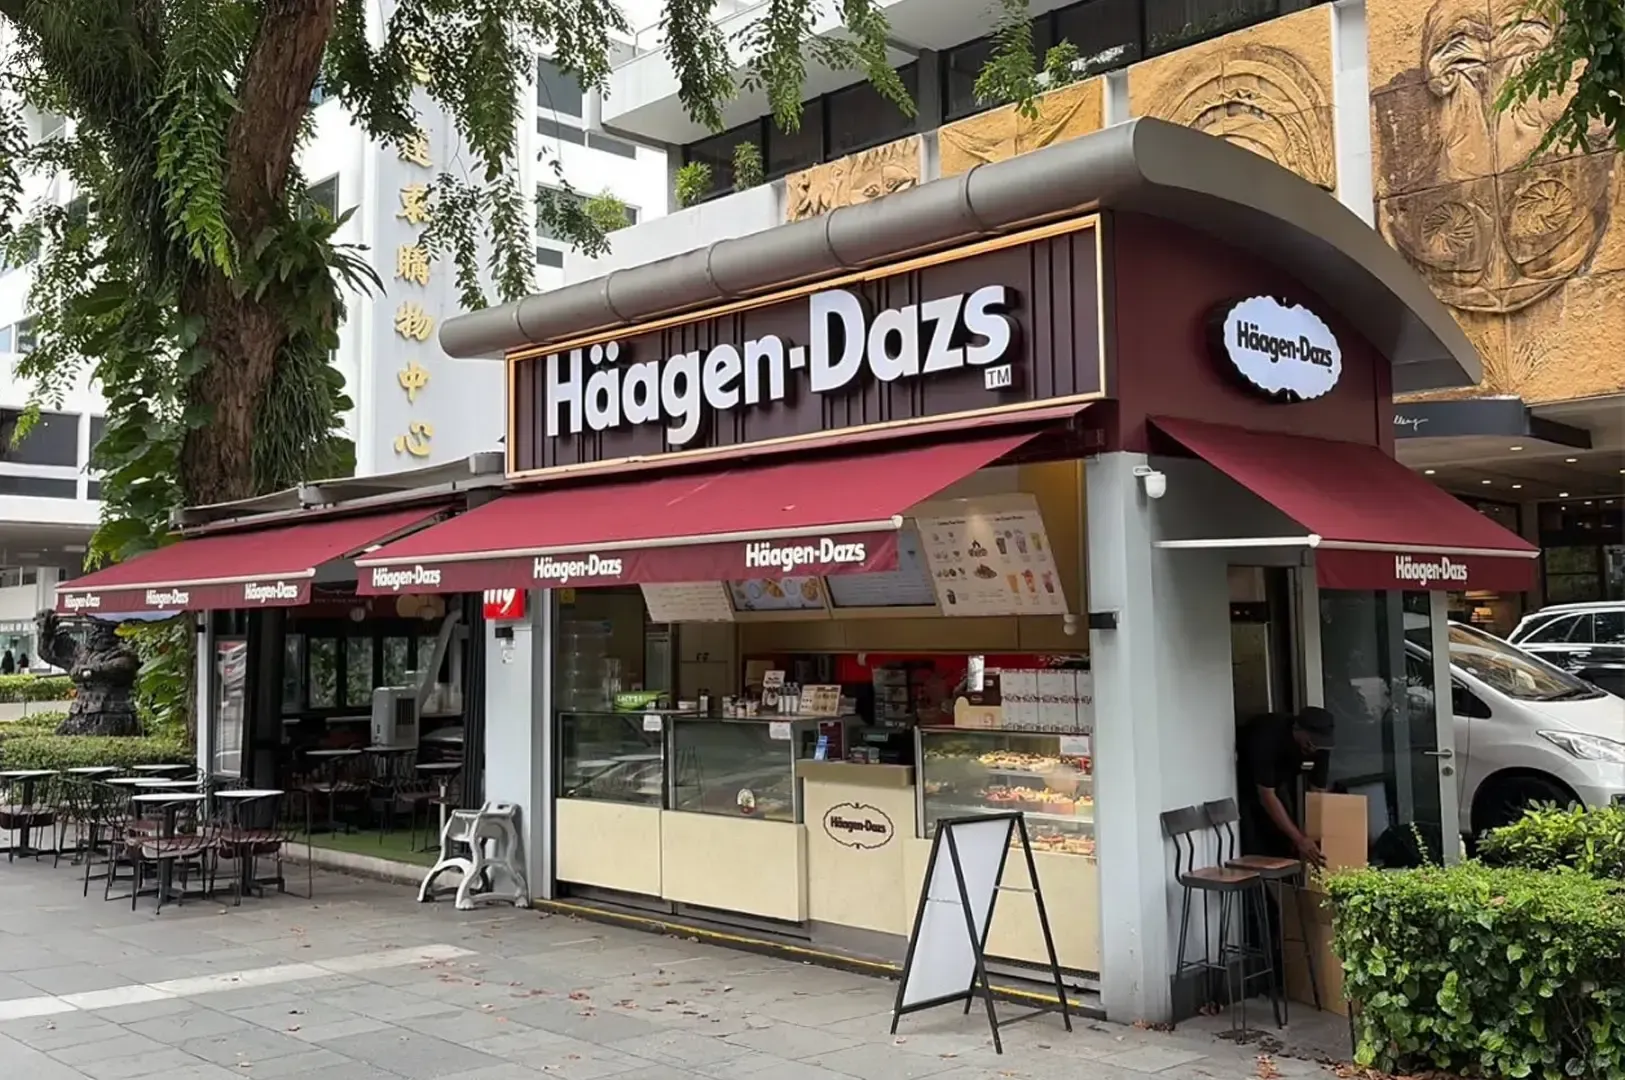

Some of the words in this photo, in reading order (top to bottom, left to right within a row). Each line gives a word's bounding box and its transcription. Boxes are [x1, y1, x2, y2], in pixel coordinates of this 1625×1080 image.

[1236, 320, 1333, 368] Häagen-Dazs
[546, 285, 1011, 444] Häagen-Dazs
[985, 366, 1011, 387] TM
[533, 554, 622, 583] Häagen-Dazs
[746, 538, 866, 572] Häagen-Dazs
[1396, 555, 1468, 586] Häagen-Dazs
[372, 565, 441, 590] Häagen-Dazs
